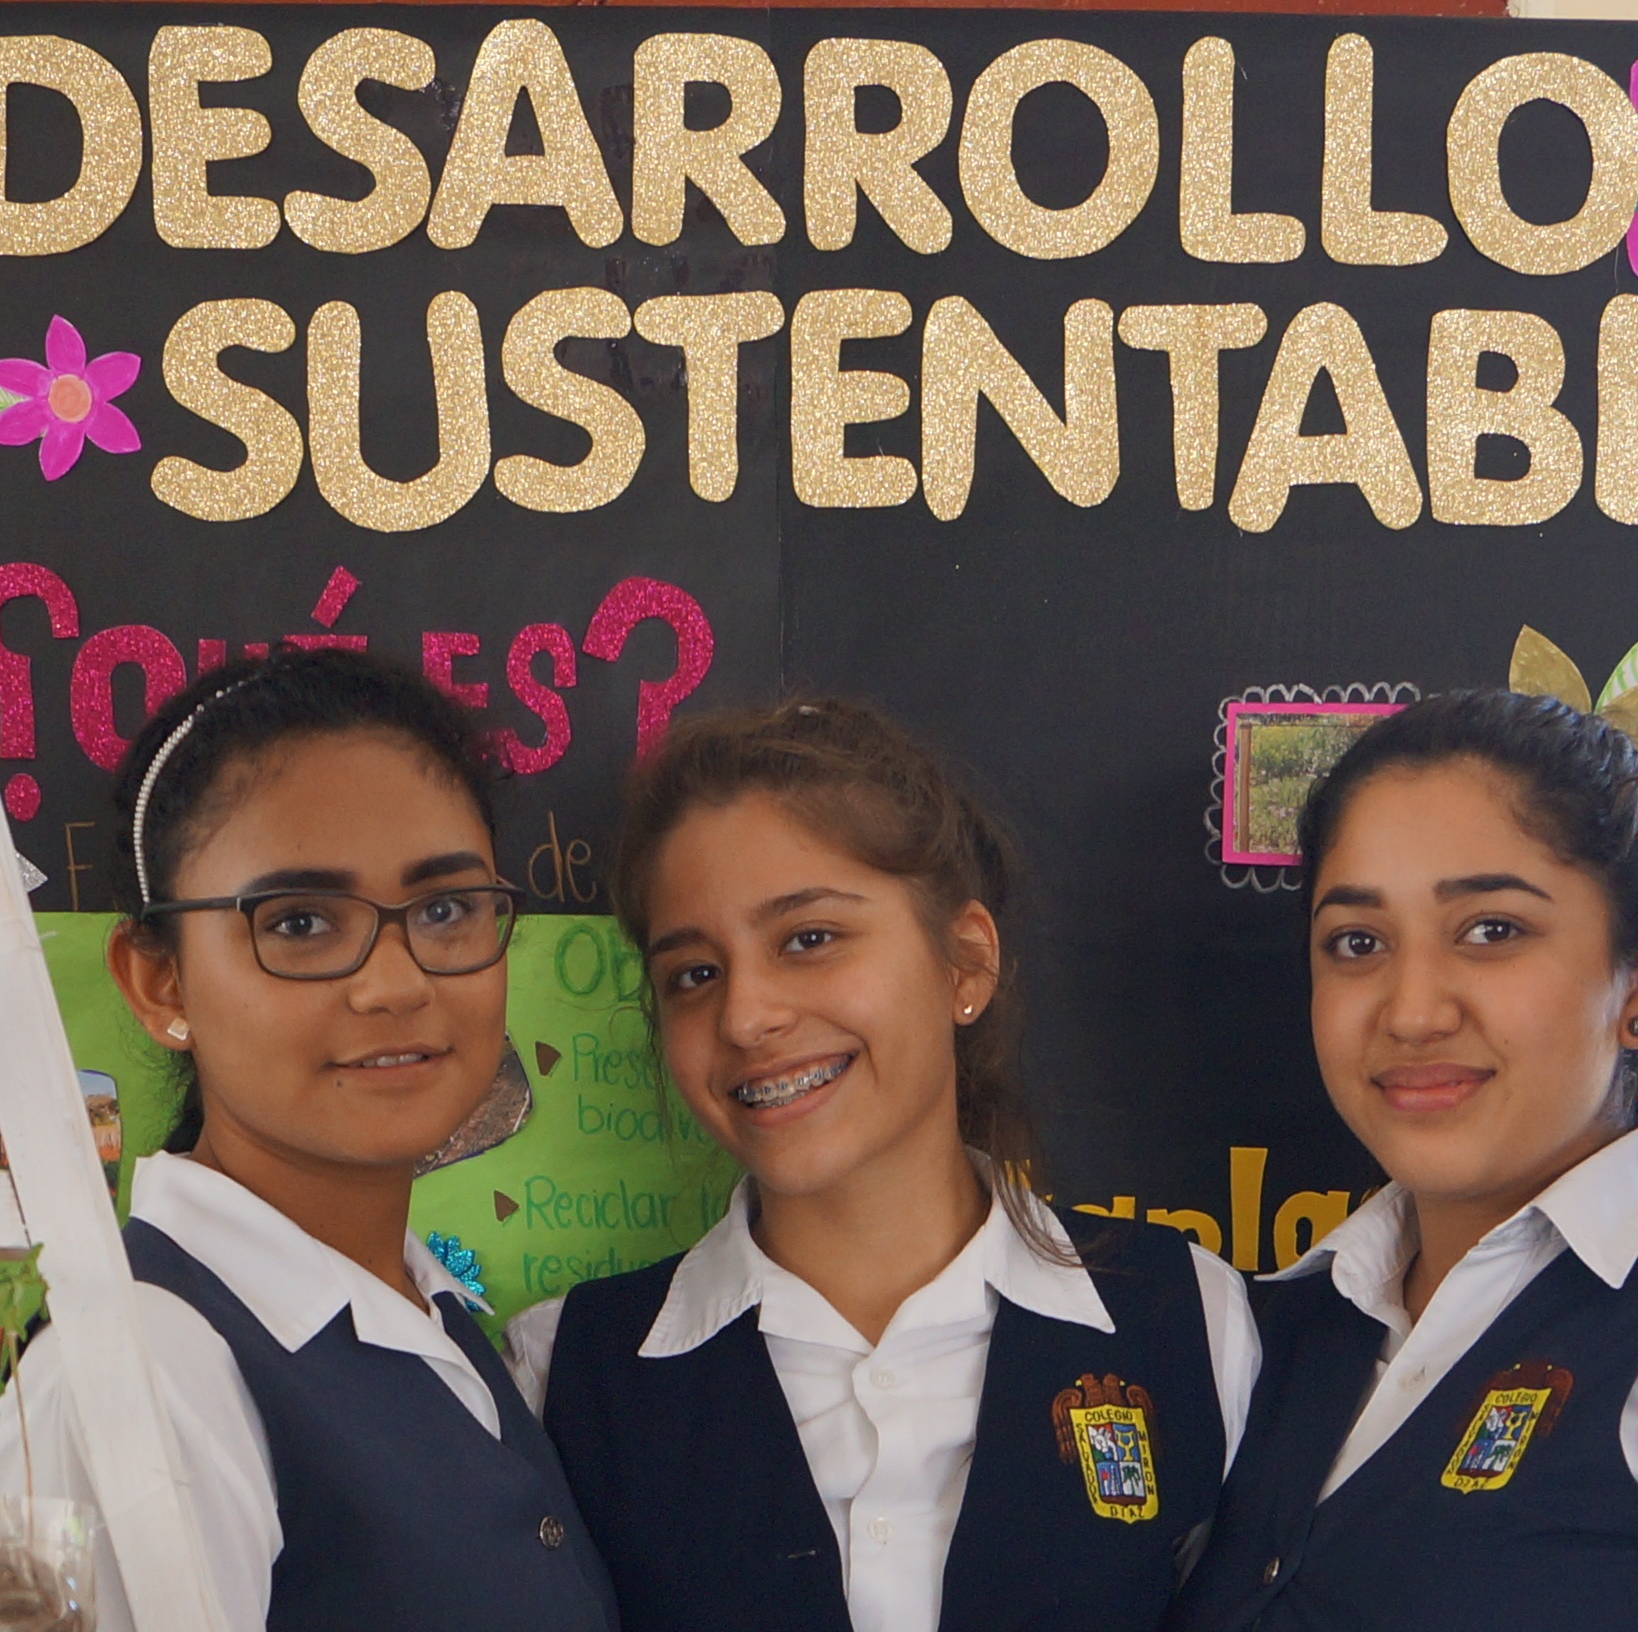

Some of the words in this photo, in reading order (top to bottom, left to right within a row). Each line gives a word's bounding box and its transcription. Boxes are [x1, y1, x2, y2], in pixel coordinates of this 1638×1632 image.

[528, 810, 600, 904] de
[553, 923, 643, 1003] Ob
[523, 1174, 679, 1231] Reciclar
[1084, 1408, 1134, 1423] COLEGIO
[1109, 1505, 1146, 1519] DIAZ
